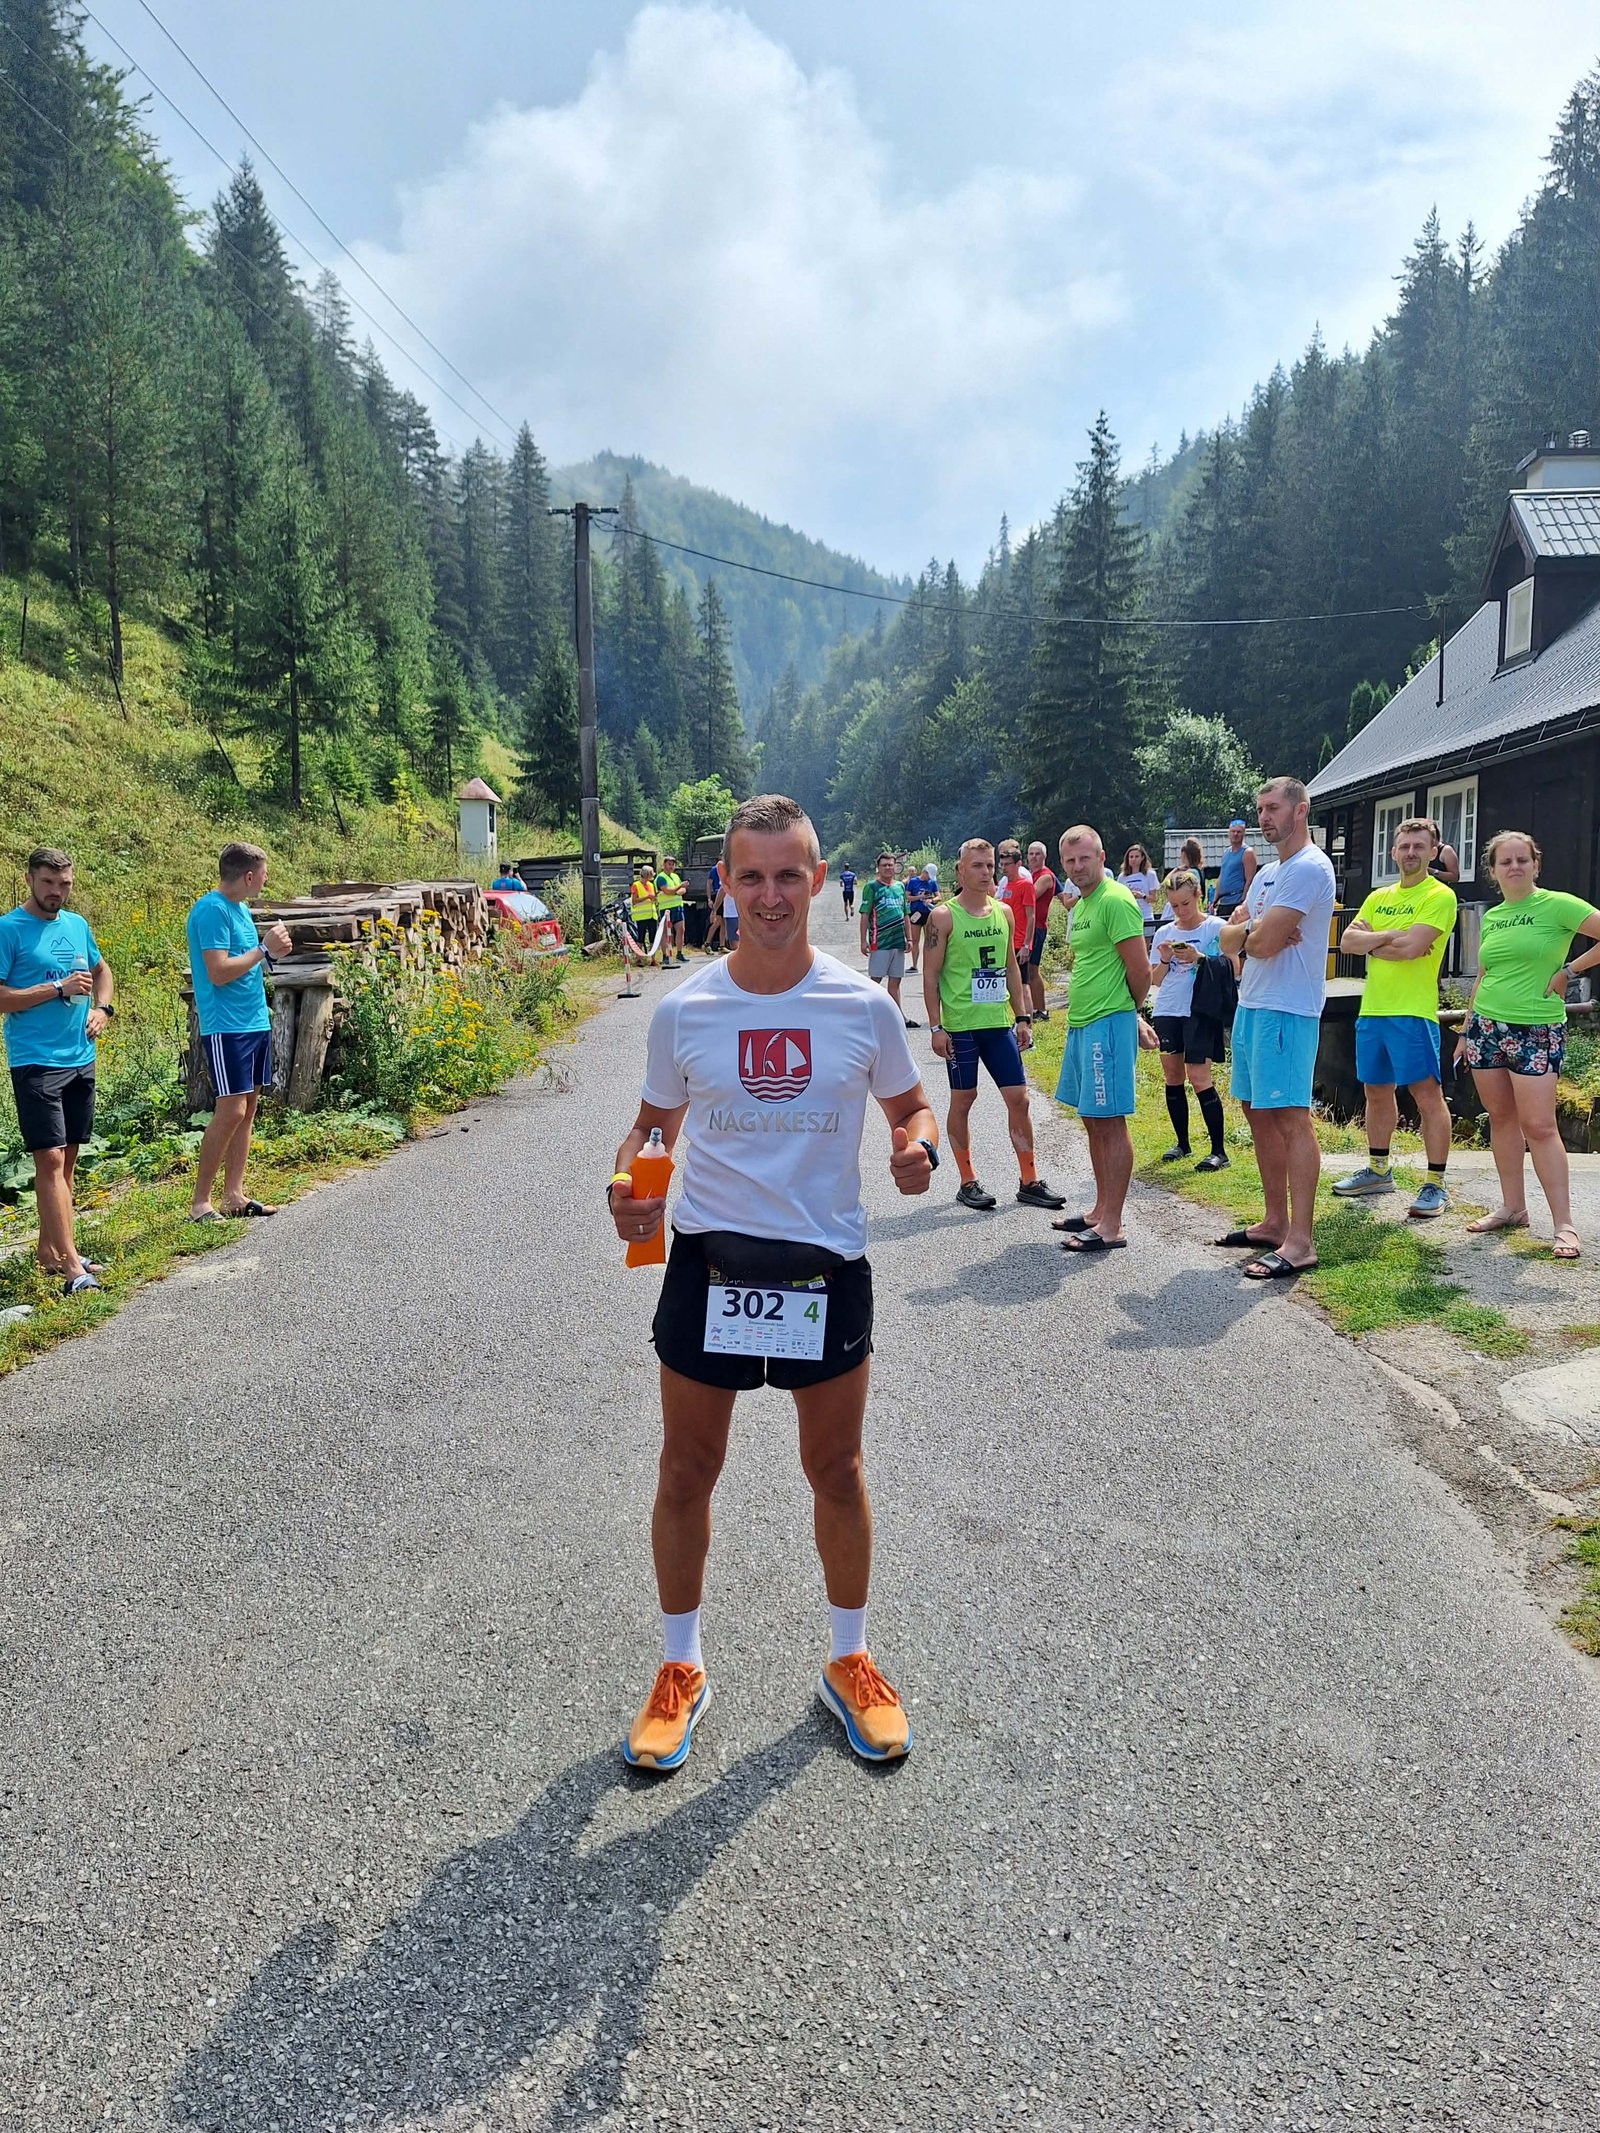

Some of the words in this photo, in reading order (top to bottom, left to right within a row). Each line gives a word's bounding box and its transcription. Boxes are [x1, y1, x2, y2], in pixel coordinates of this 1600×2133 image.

[964, 926, 1003, 938] ANGLIČÁK
[977, 979, 998, 989] 076
[709, 1109, 840, 1133] NAGYKESZI
[722, 1289, 784, 1321] 302
[804, 1301, 819, 1323] 4
